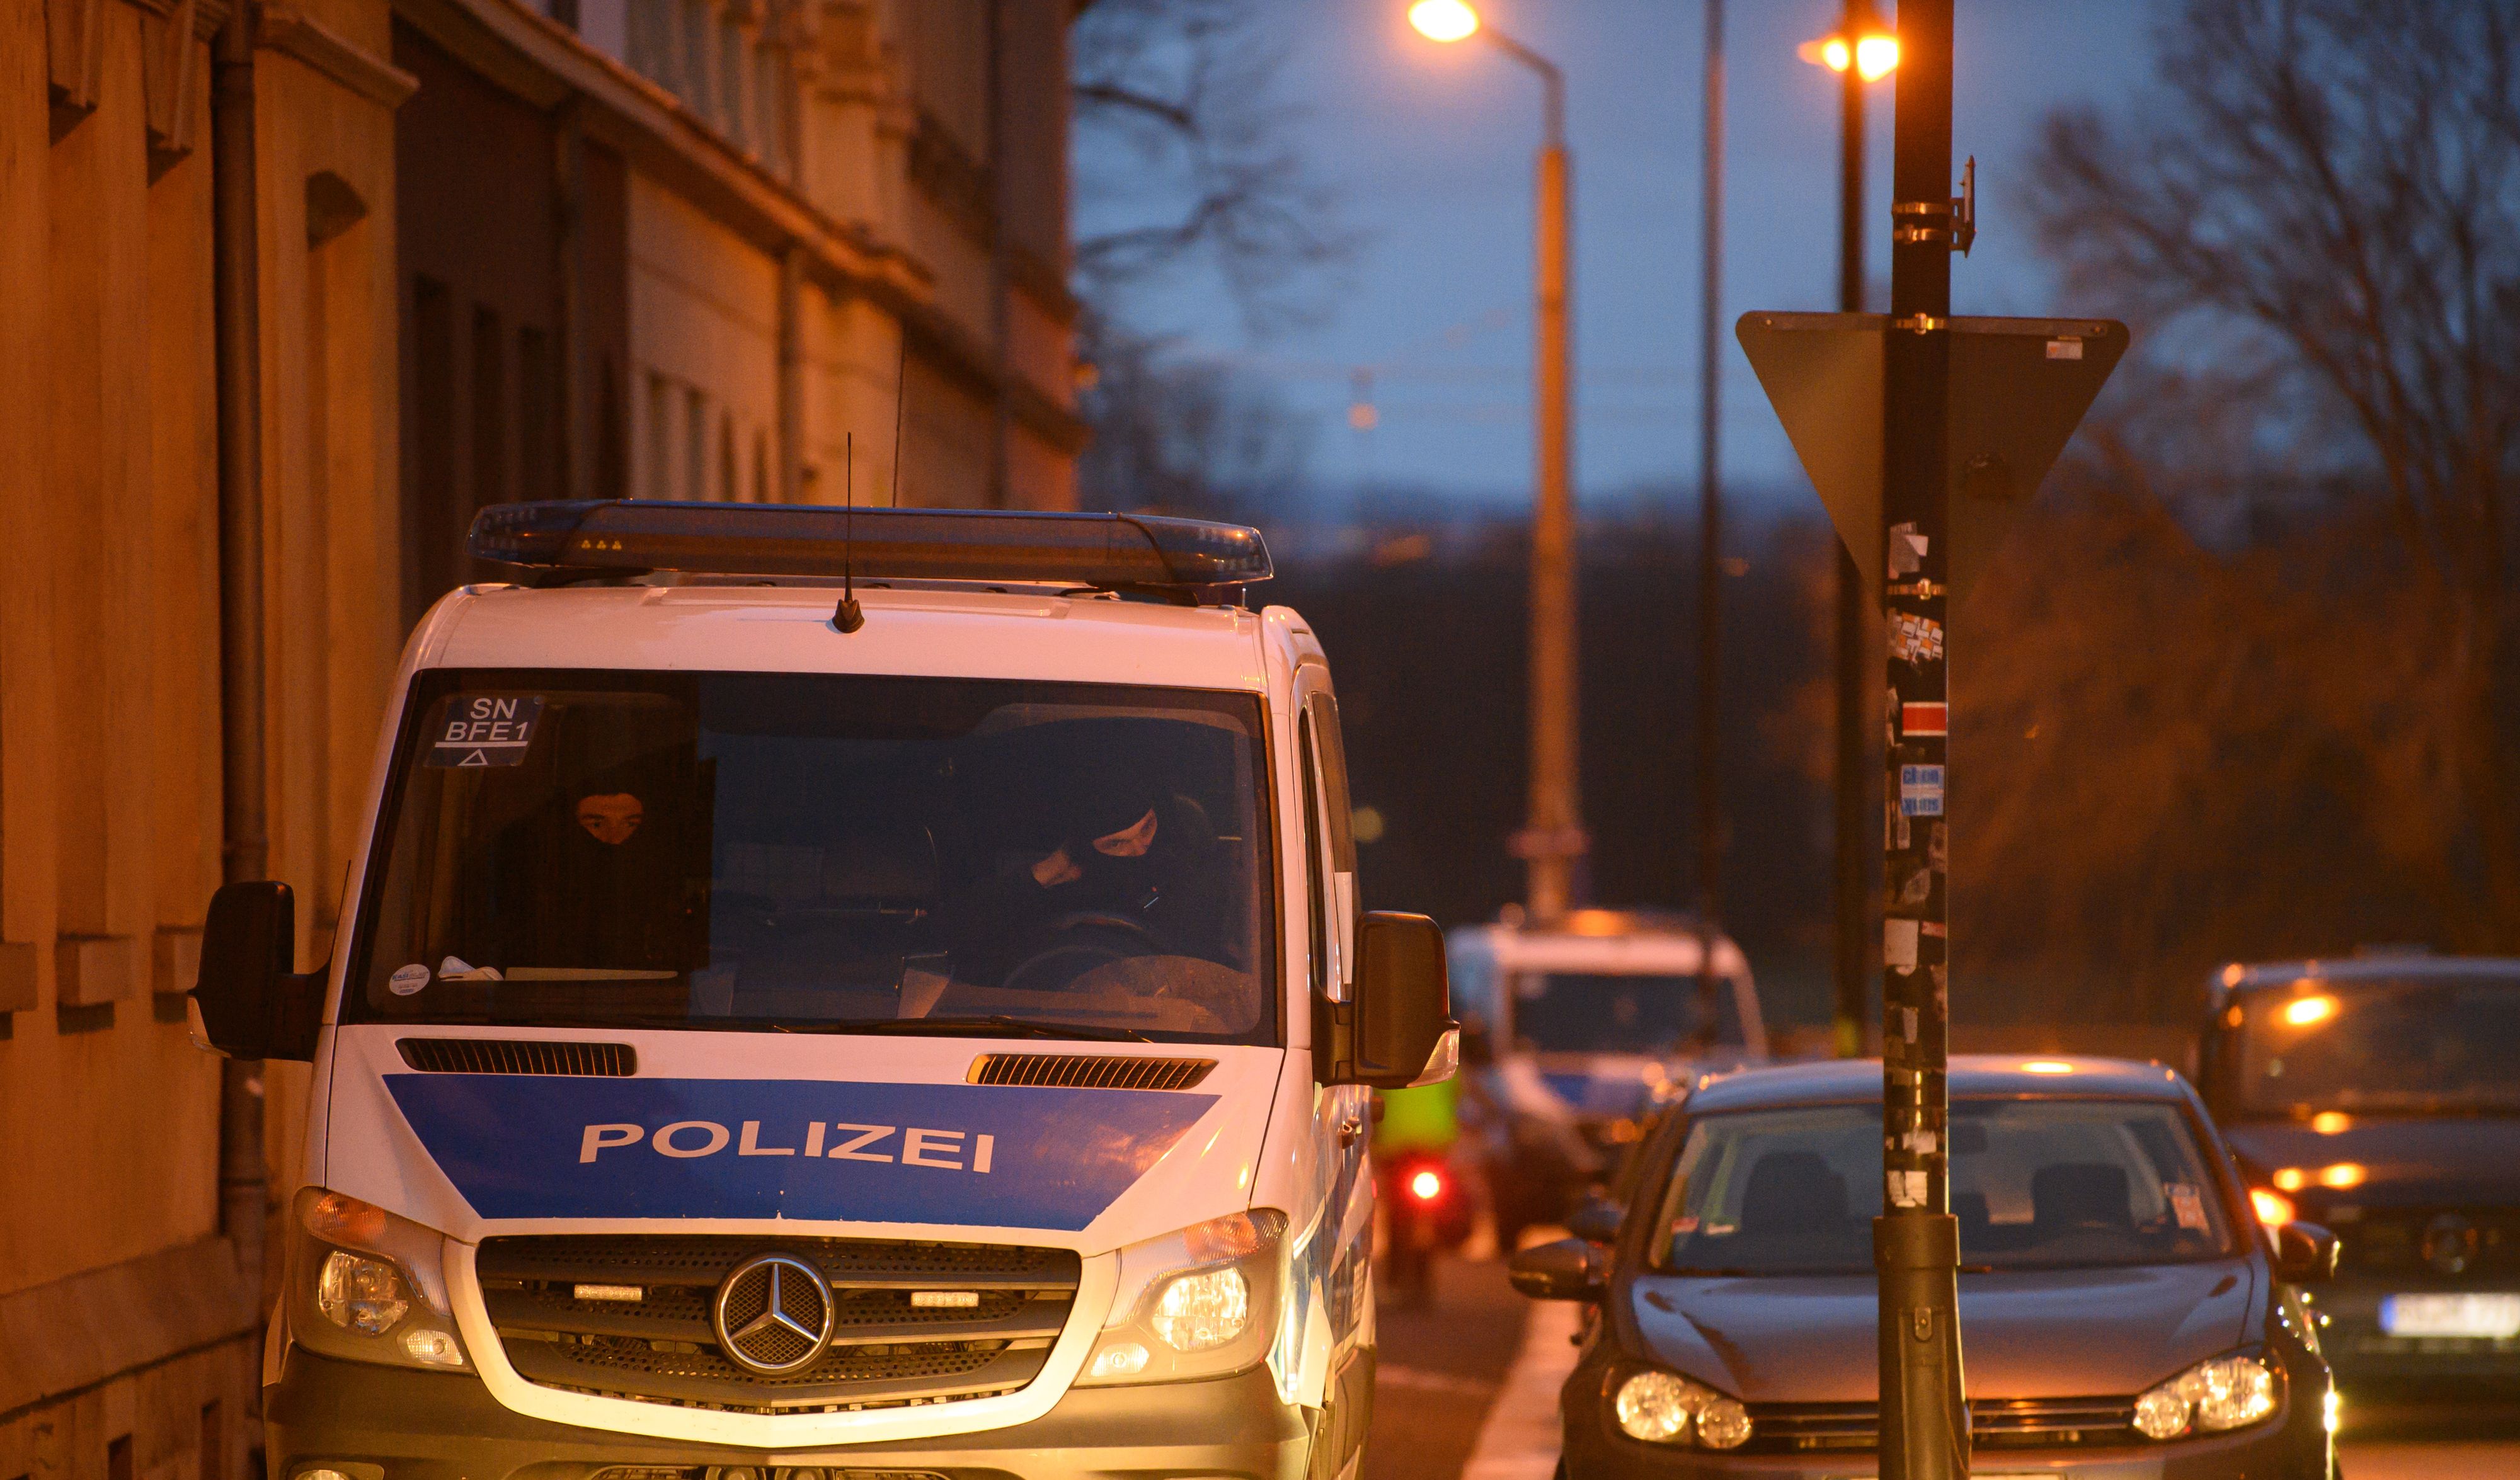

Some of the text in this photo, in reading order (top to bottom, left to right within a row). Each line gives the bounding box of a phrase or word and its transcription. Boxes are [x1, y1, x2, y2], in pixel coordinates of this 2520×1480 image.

[470, 698, 517, 719] SN
[445, 722, 528, 741] BFE1
[579, 1120, 995, 1173] POLIZEI
